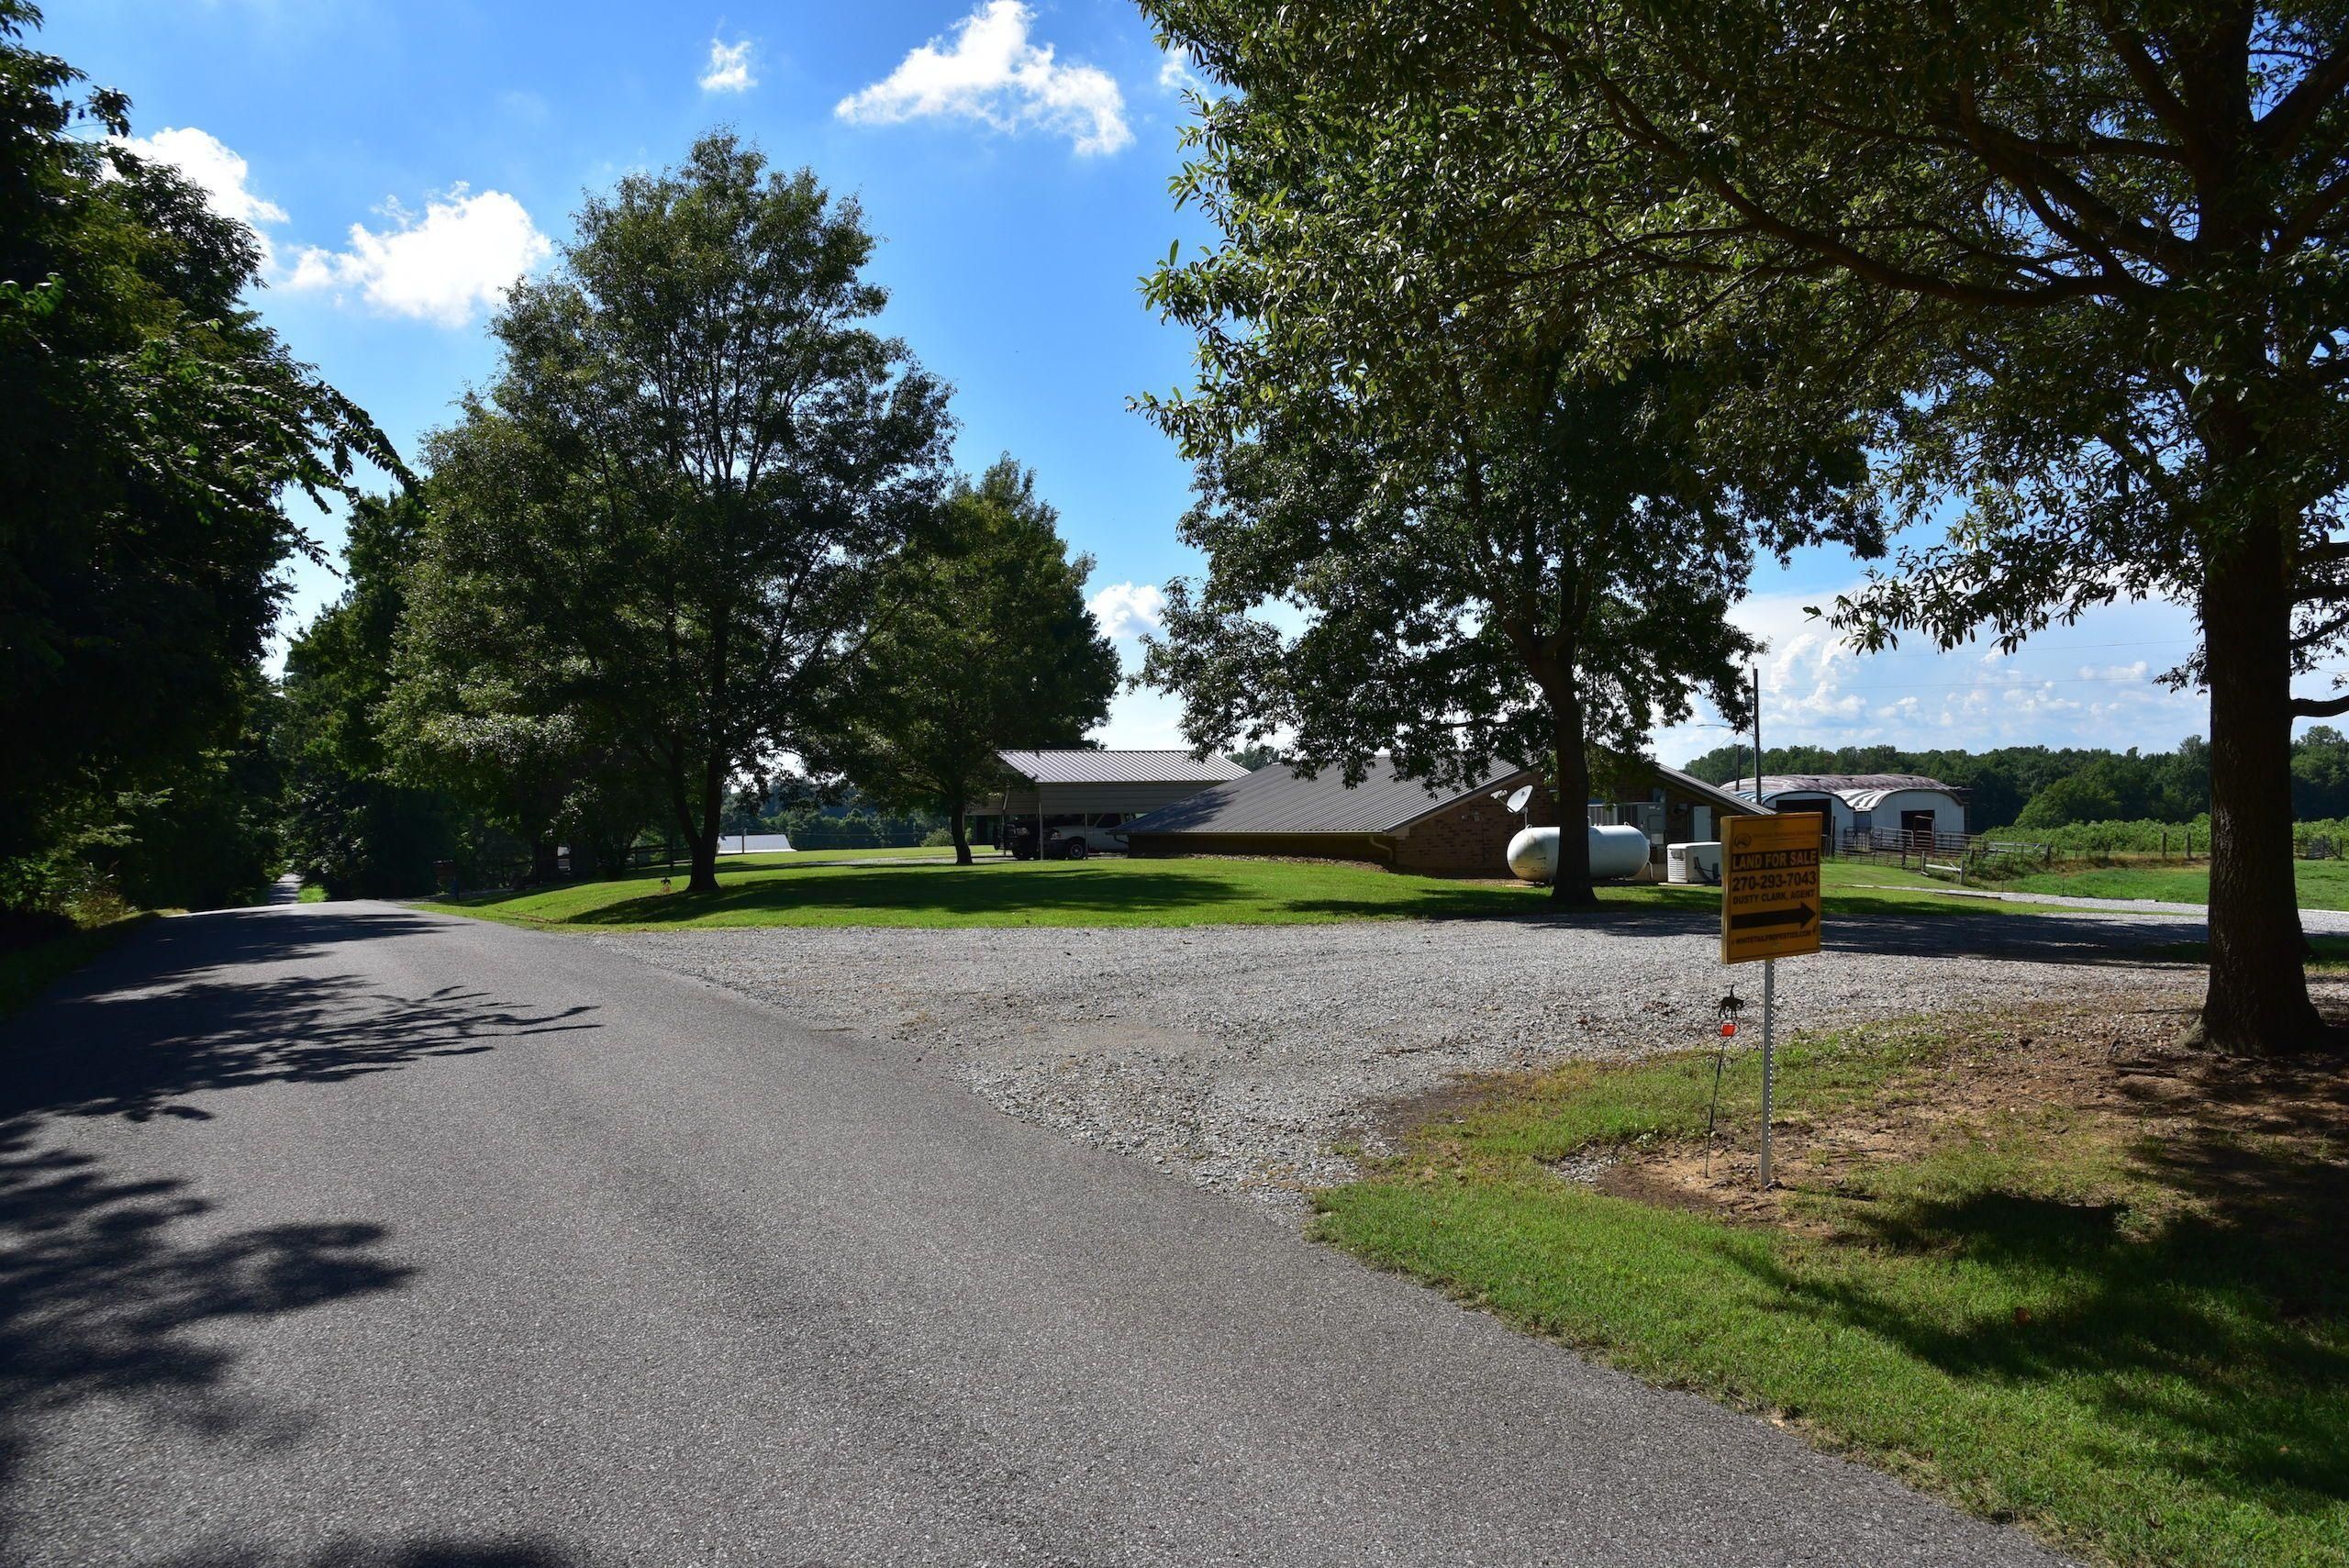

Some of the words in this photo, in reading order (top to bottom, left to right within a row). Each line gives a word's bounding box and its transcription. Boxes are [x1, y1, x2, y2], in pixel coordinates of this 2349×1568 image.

[1733, 853, 1763, 870] LAND
[1765, 852, 1787, 868] FOR
[1790, 850, 1817, 866] SALE
[1732, 871, 1816, 891] 270-293-7043
[1733, 894, 1759, 905] DUSTY
[1791, 889, 1816, 899] AGENT
